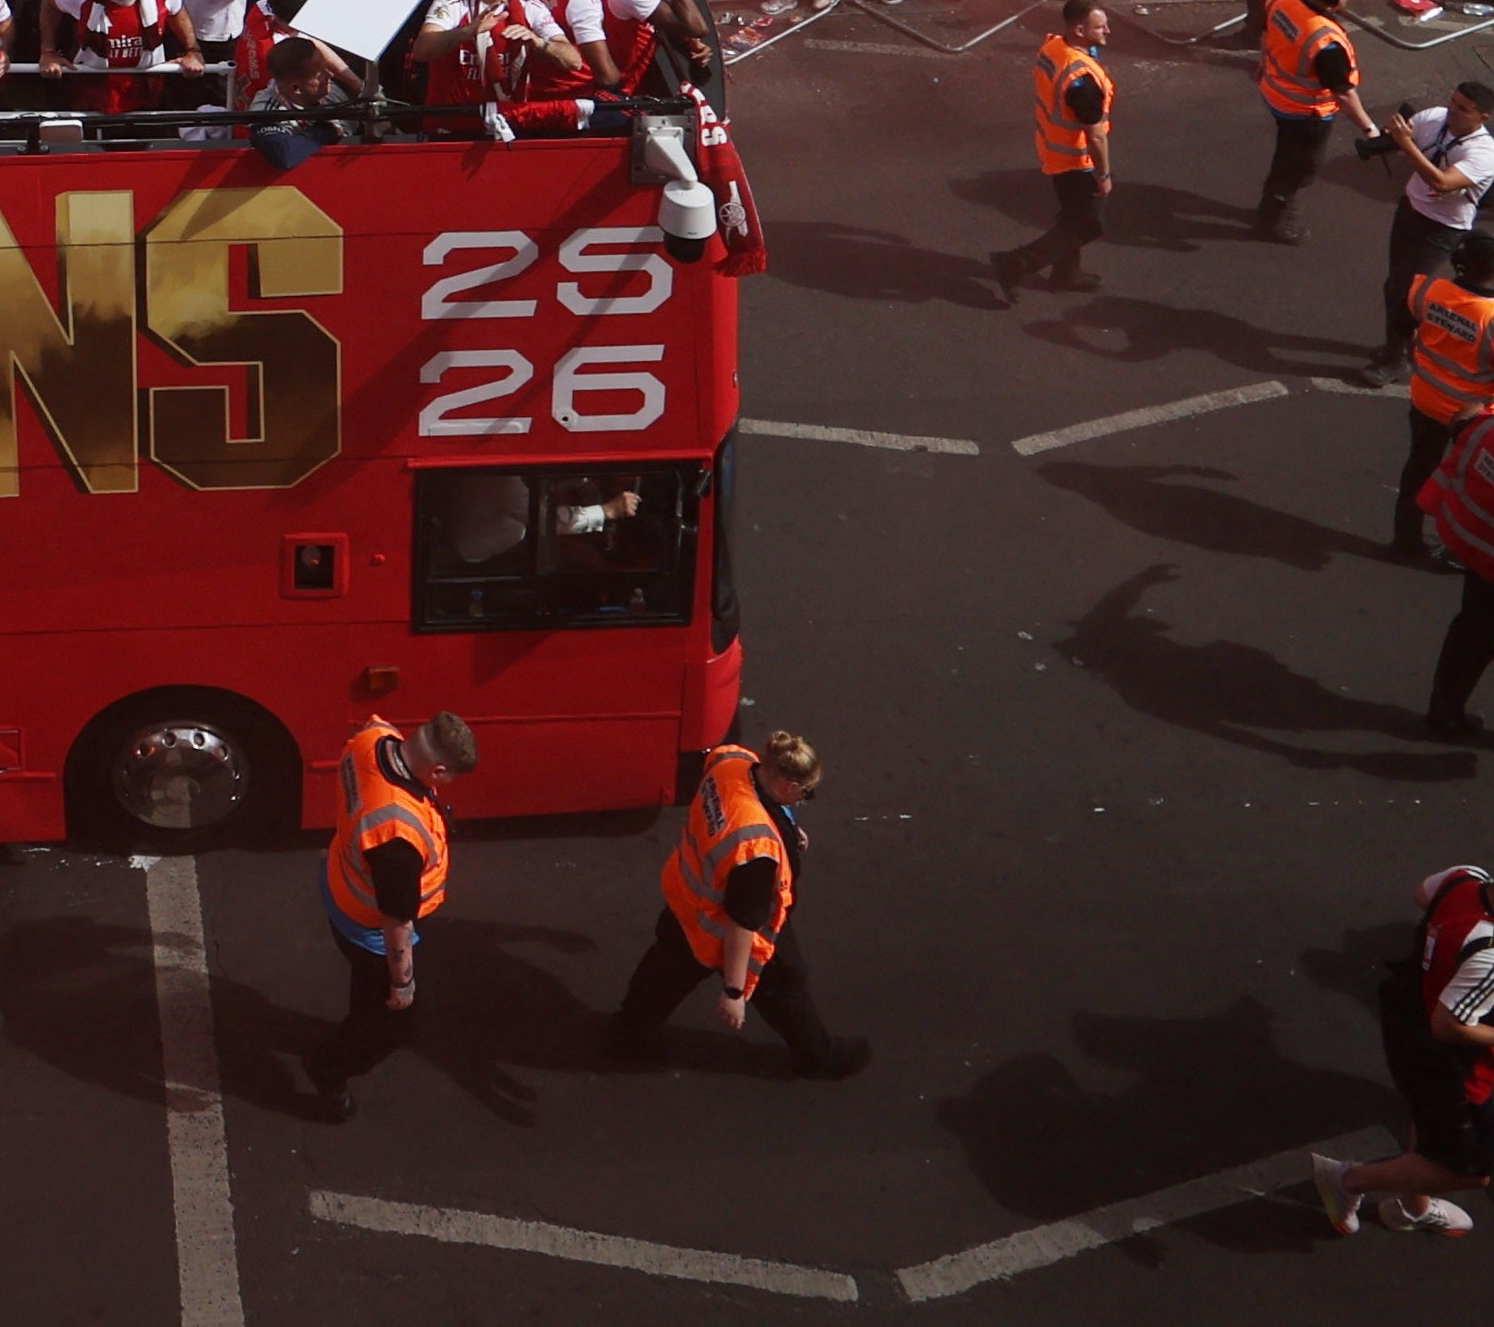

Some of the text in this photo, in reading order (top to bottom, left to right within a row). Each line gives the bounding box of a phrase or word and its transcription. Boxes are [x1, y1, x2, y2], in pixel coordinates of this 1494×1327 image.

[420, 225, 673, 320] 25
[1427, 312, 1476, 343] STEWARD
[1428, 303, 1476, 332] ARSENAL
[418, 344, 668, 438] 26
